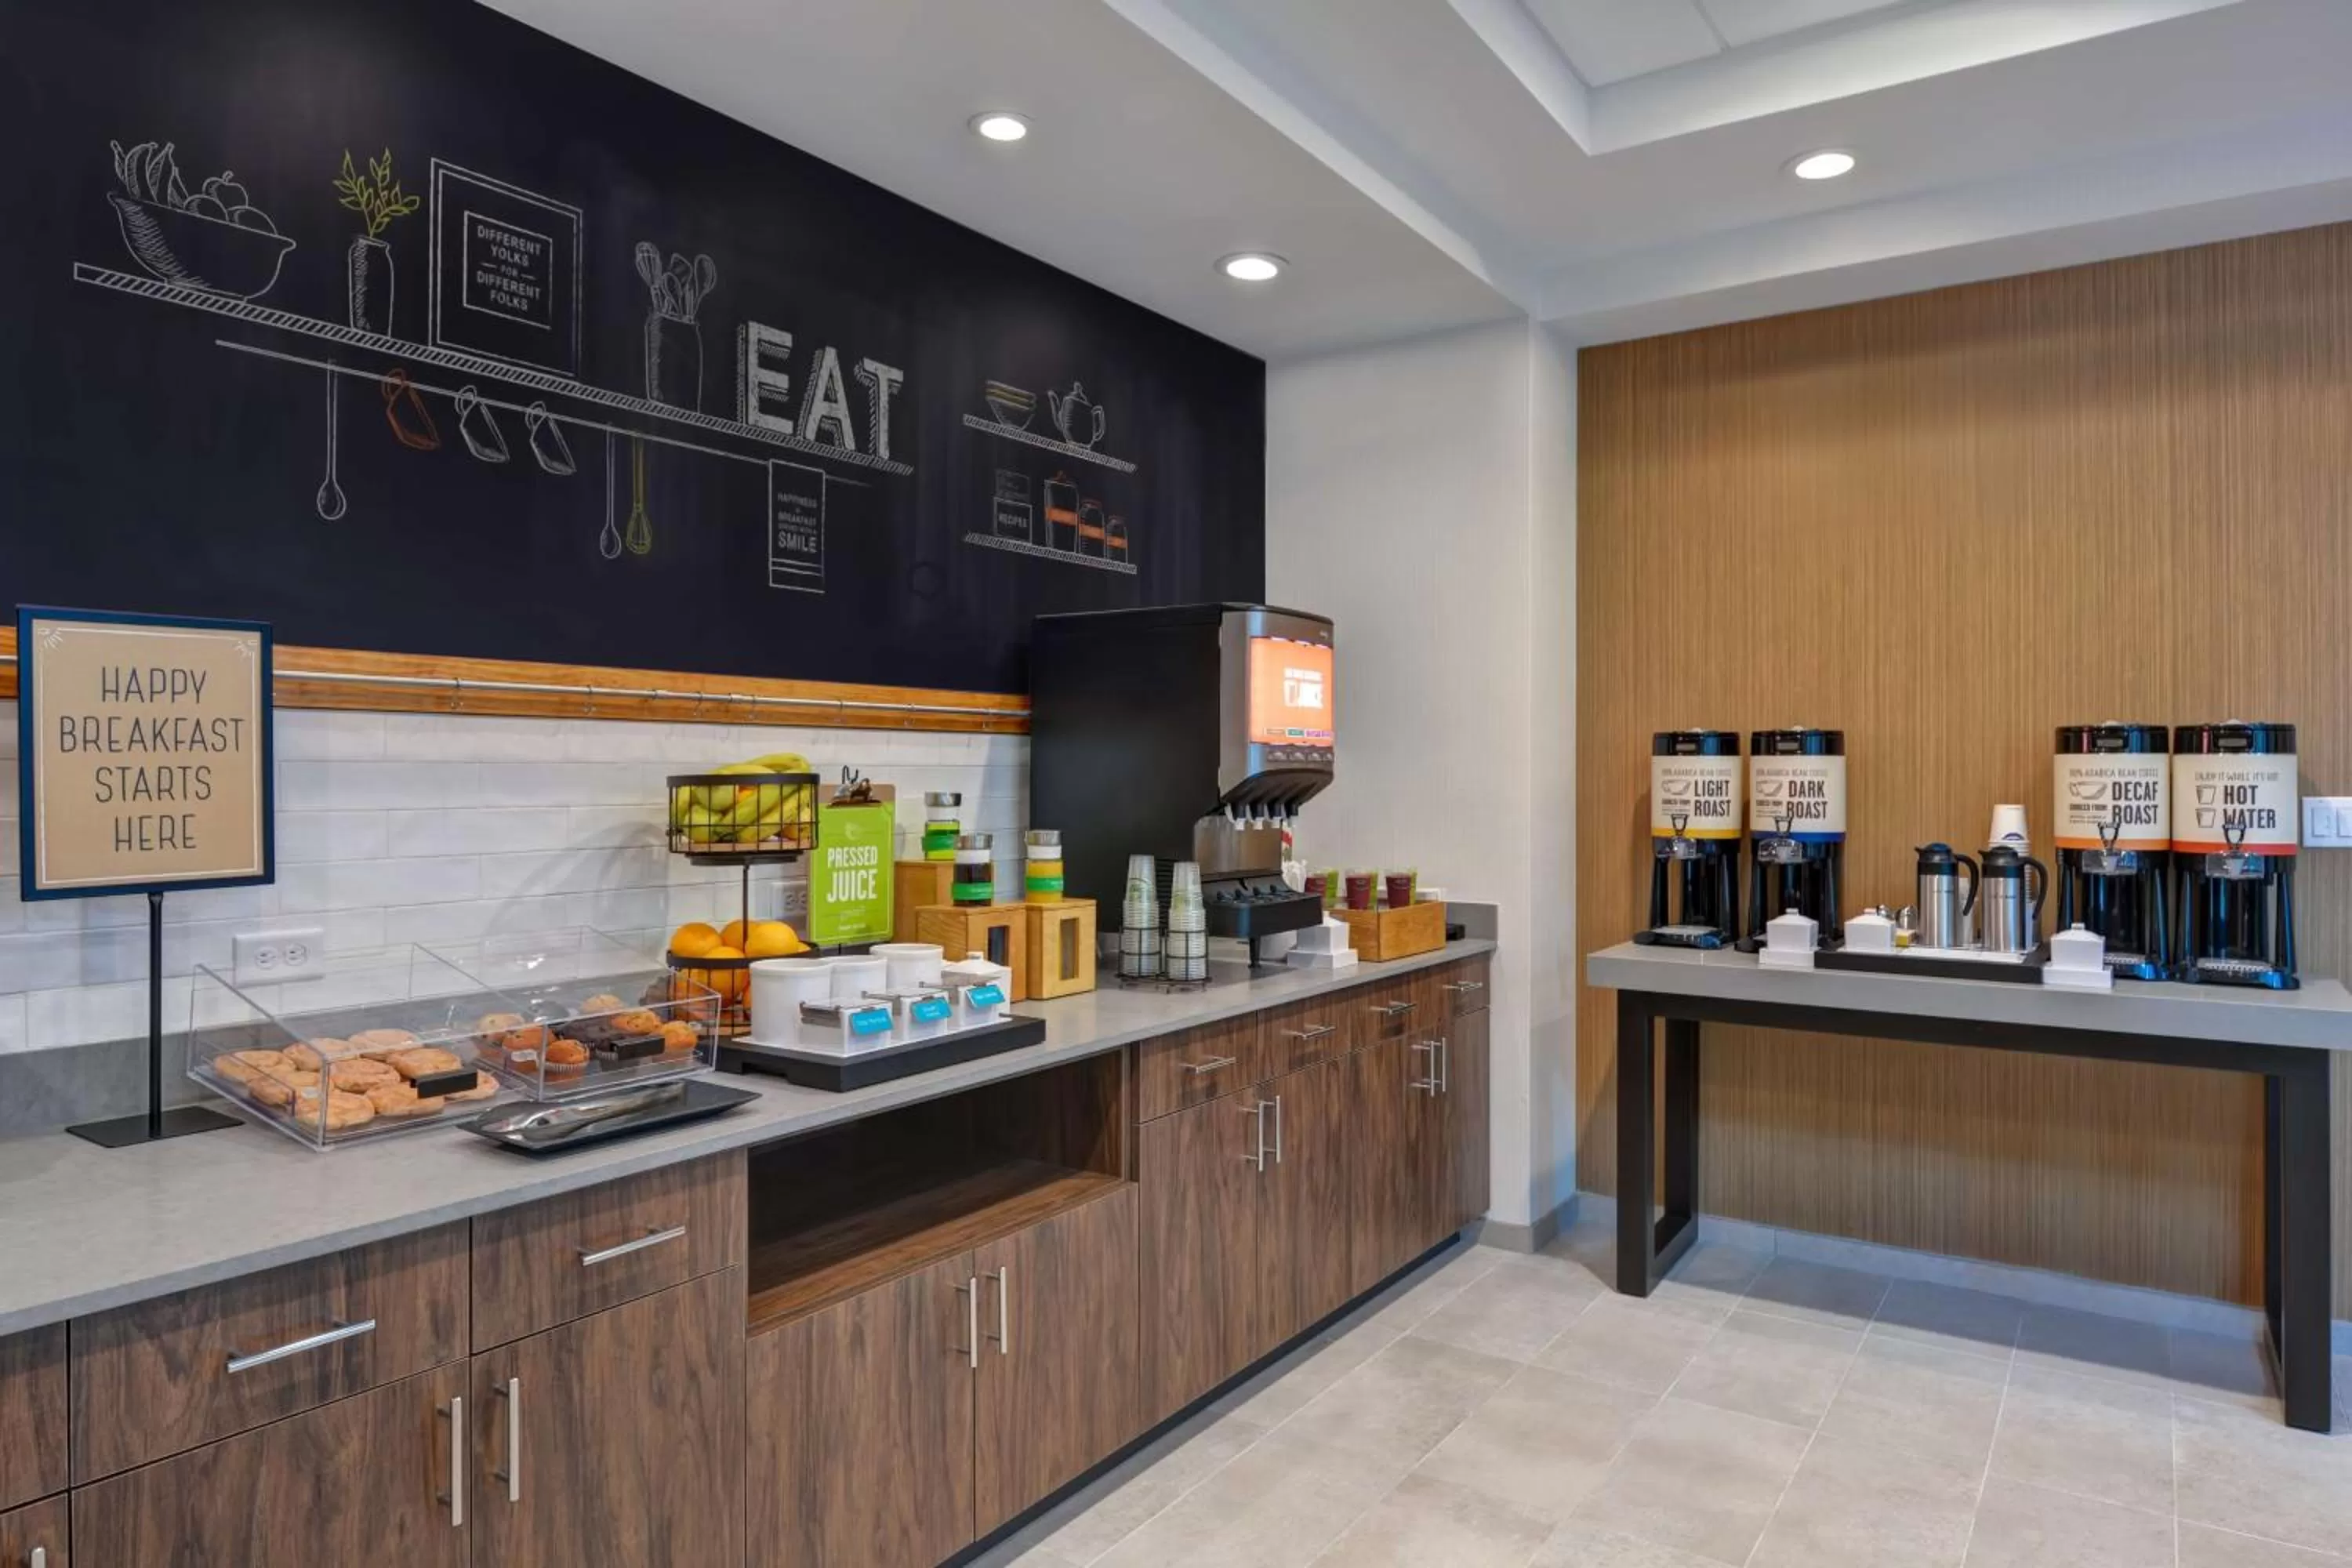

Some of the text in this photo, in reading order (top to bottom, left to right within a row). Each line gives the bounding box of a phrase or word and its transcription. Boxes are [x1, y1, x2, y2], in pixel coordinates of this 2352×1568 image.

[477, 225, 542, 256] DIFFERENT
[490, 244, 529, 267] YOLKS
[476, 270, 541, 300] DIFFERENT
[490, 289, 528, 312] FOLKS
[738, 320, 904, 459] EAT
[779, 530, 817, 554] SMILE
[102, 666, 206, 703] HAPPY
[60, 716, 245, 753] BREAKFAST
[95, 765, 212, 803] STARTS
[1694, 779, 1730, 797] LIGHT
[1788, 780, 1825, 798] DARK
[2111, 781, 2158, 801] DECAF
[2224, 785, 2259, 805] HOT
[1694, 799, 1732, 817] ROAST
[1787, 800, 1828, 819] ROAST
[2111, 804, 2158, 826] ROAST
[2223, 808, 2276, 829] WATER
[115, 813, 197, 851] HERE
[827, 846, 878, 868] PRESSED
[826, 869, 878, 903] JUICE
